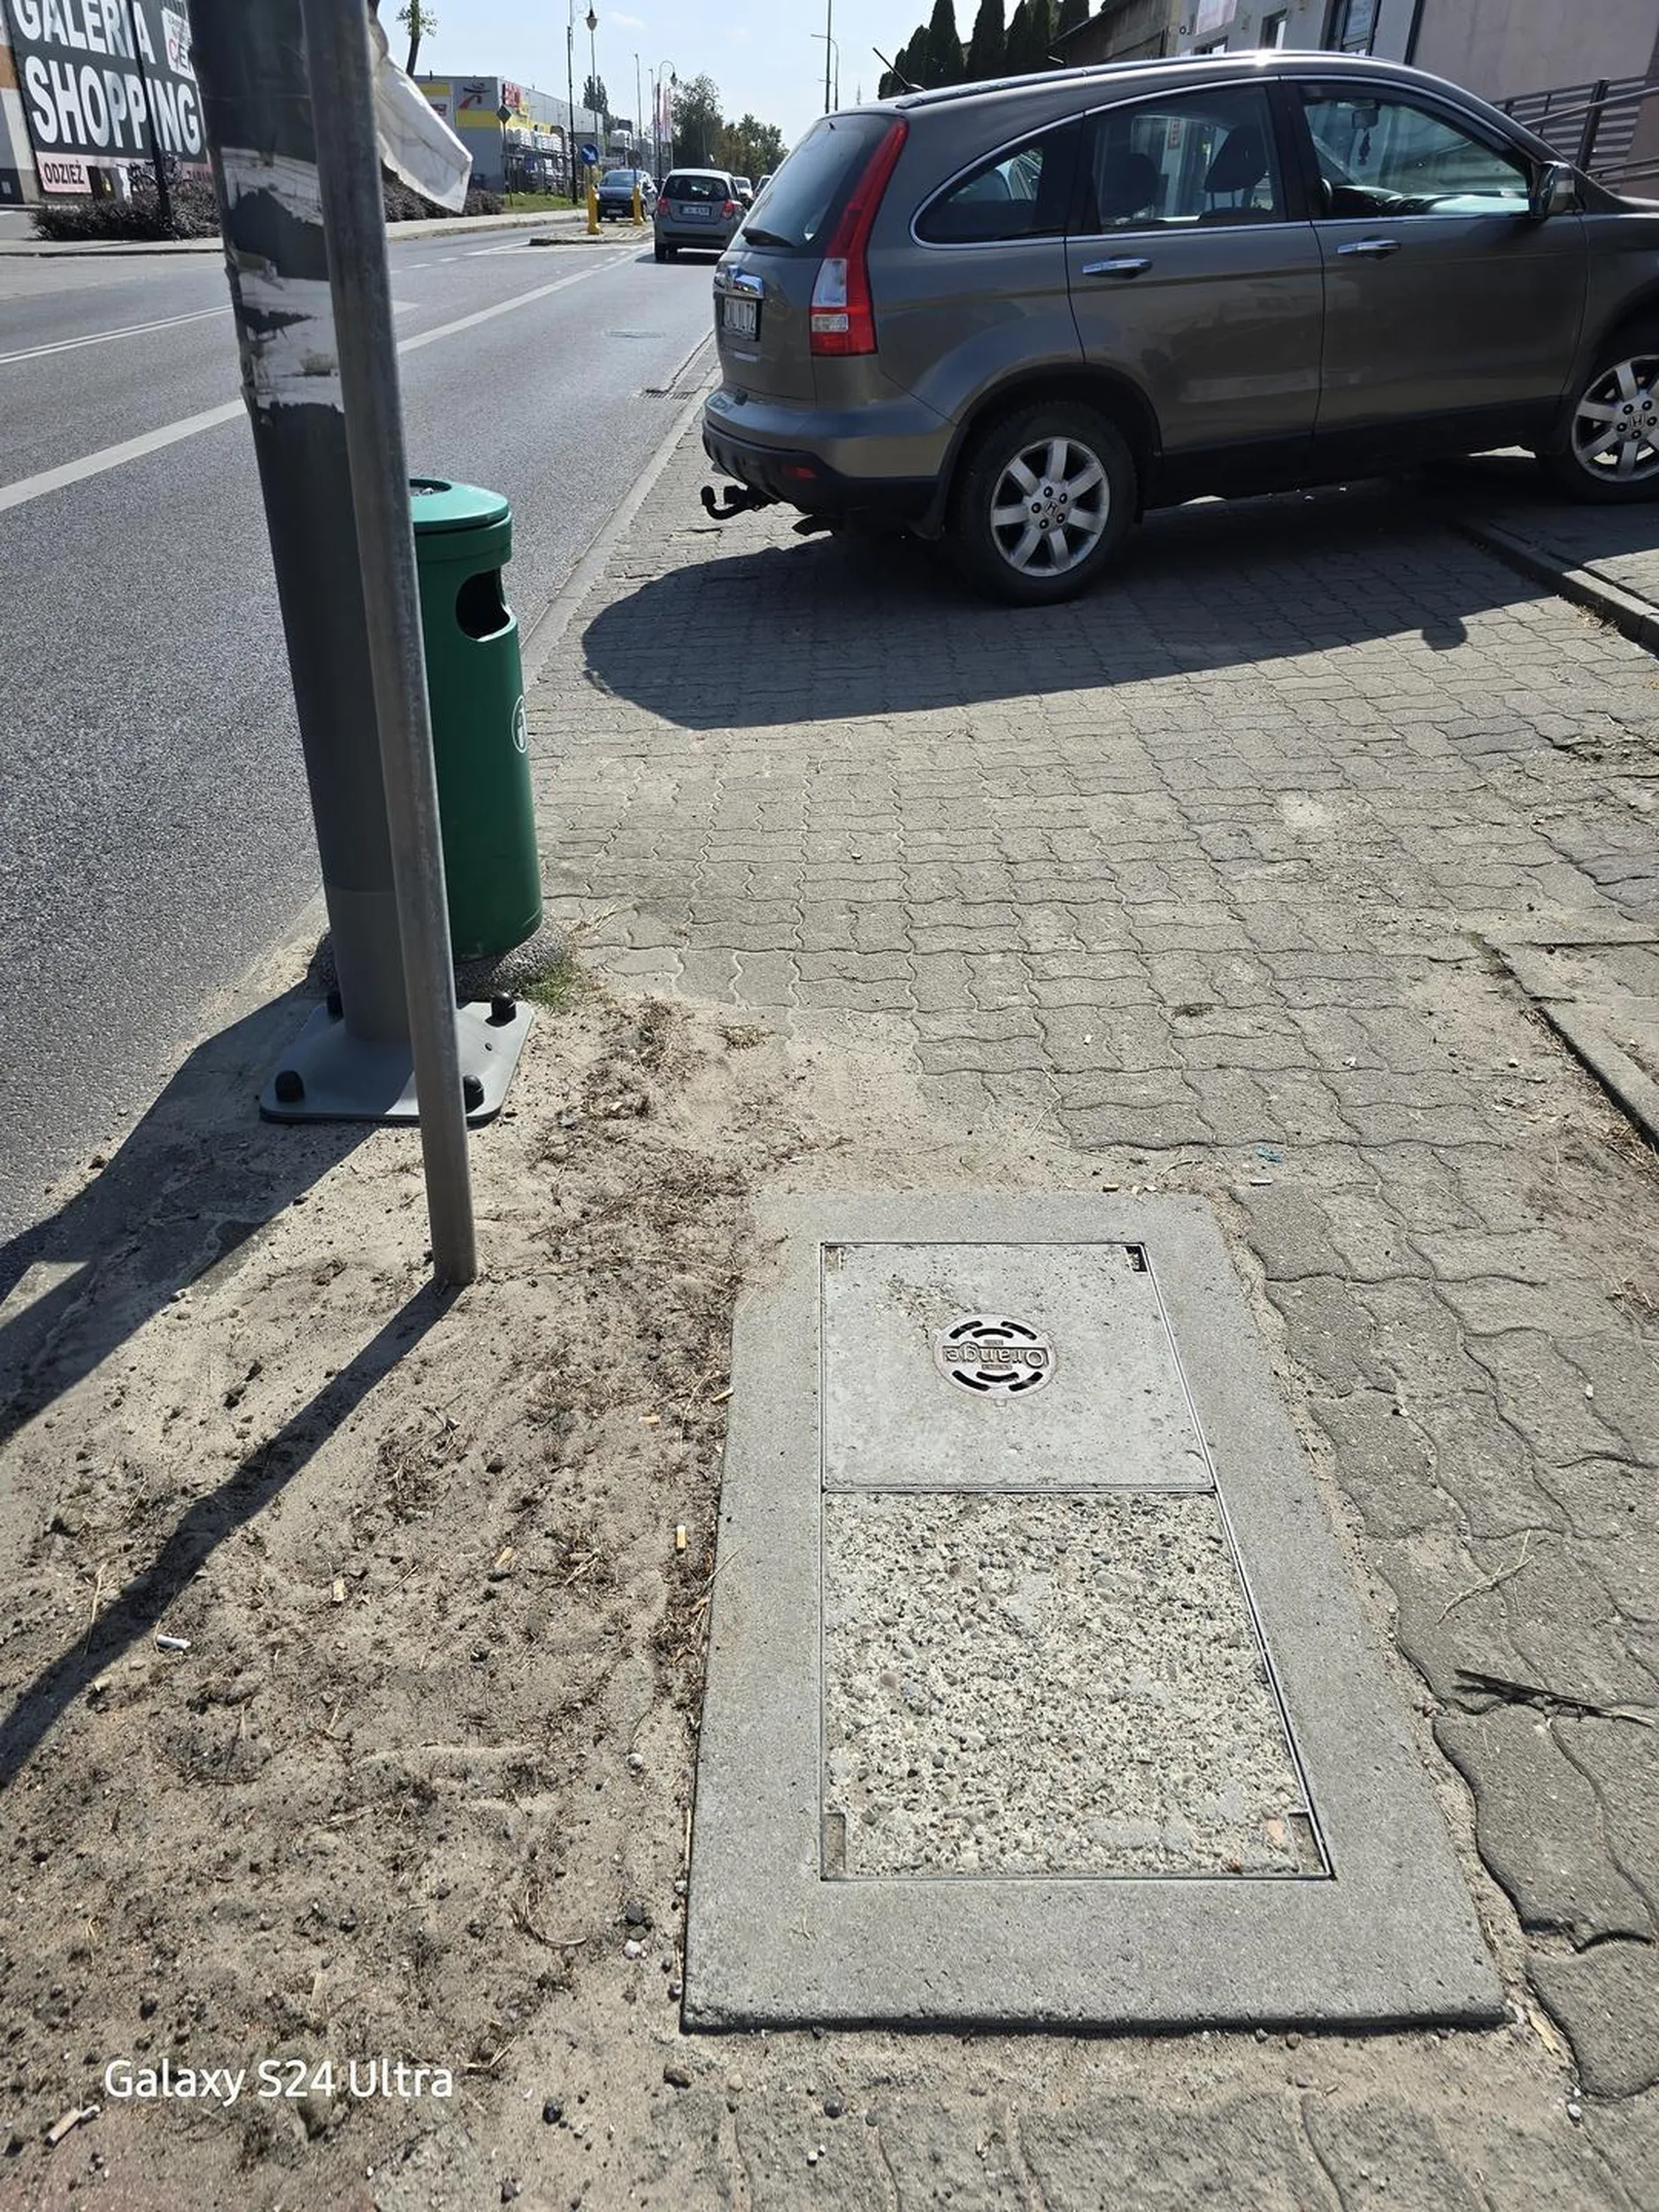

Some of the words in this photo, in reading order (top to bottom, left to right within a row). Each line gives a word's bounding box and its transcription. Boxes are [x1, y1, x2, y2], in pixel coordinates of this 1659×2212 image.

[12, 0, 157, 65] GALERIA
[25, 56, 202, 155] SHOPPING
[44, 160, 85, 185] ODZIEŻ
[945, 1341, 1047, 1369] Orange
